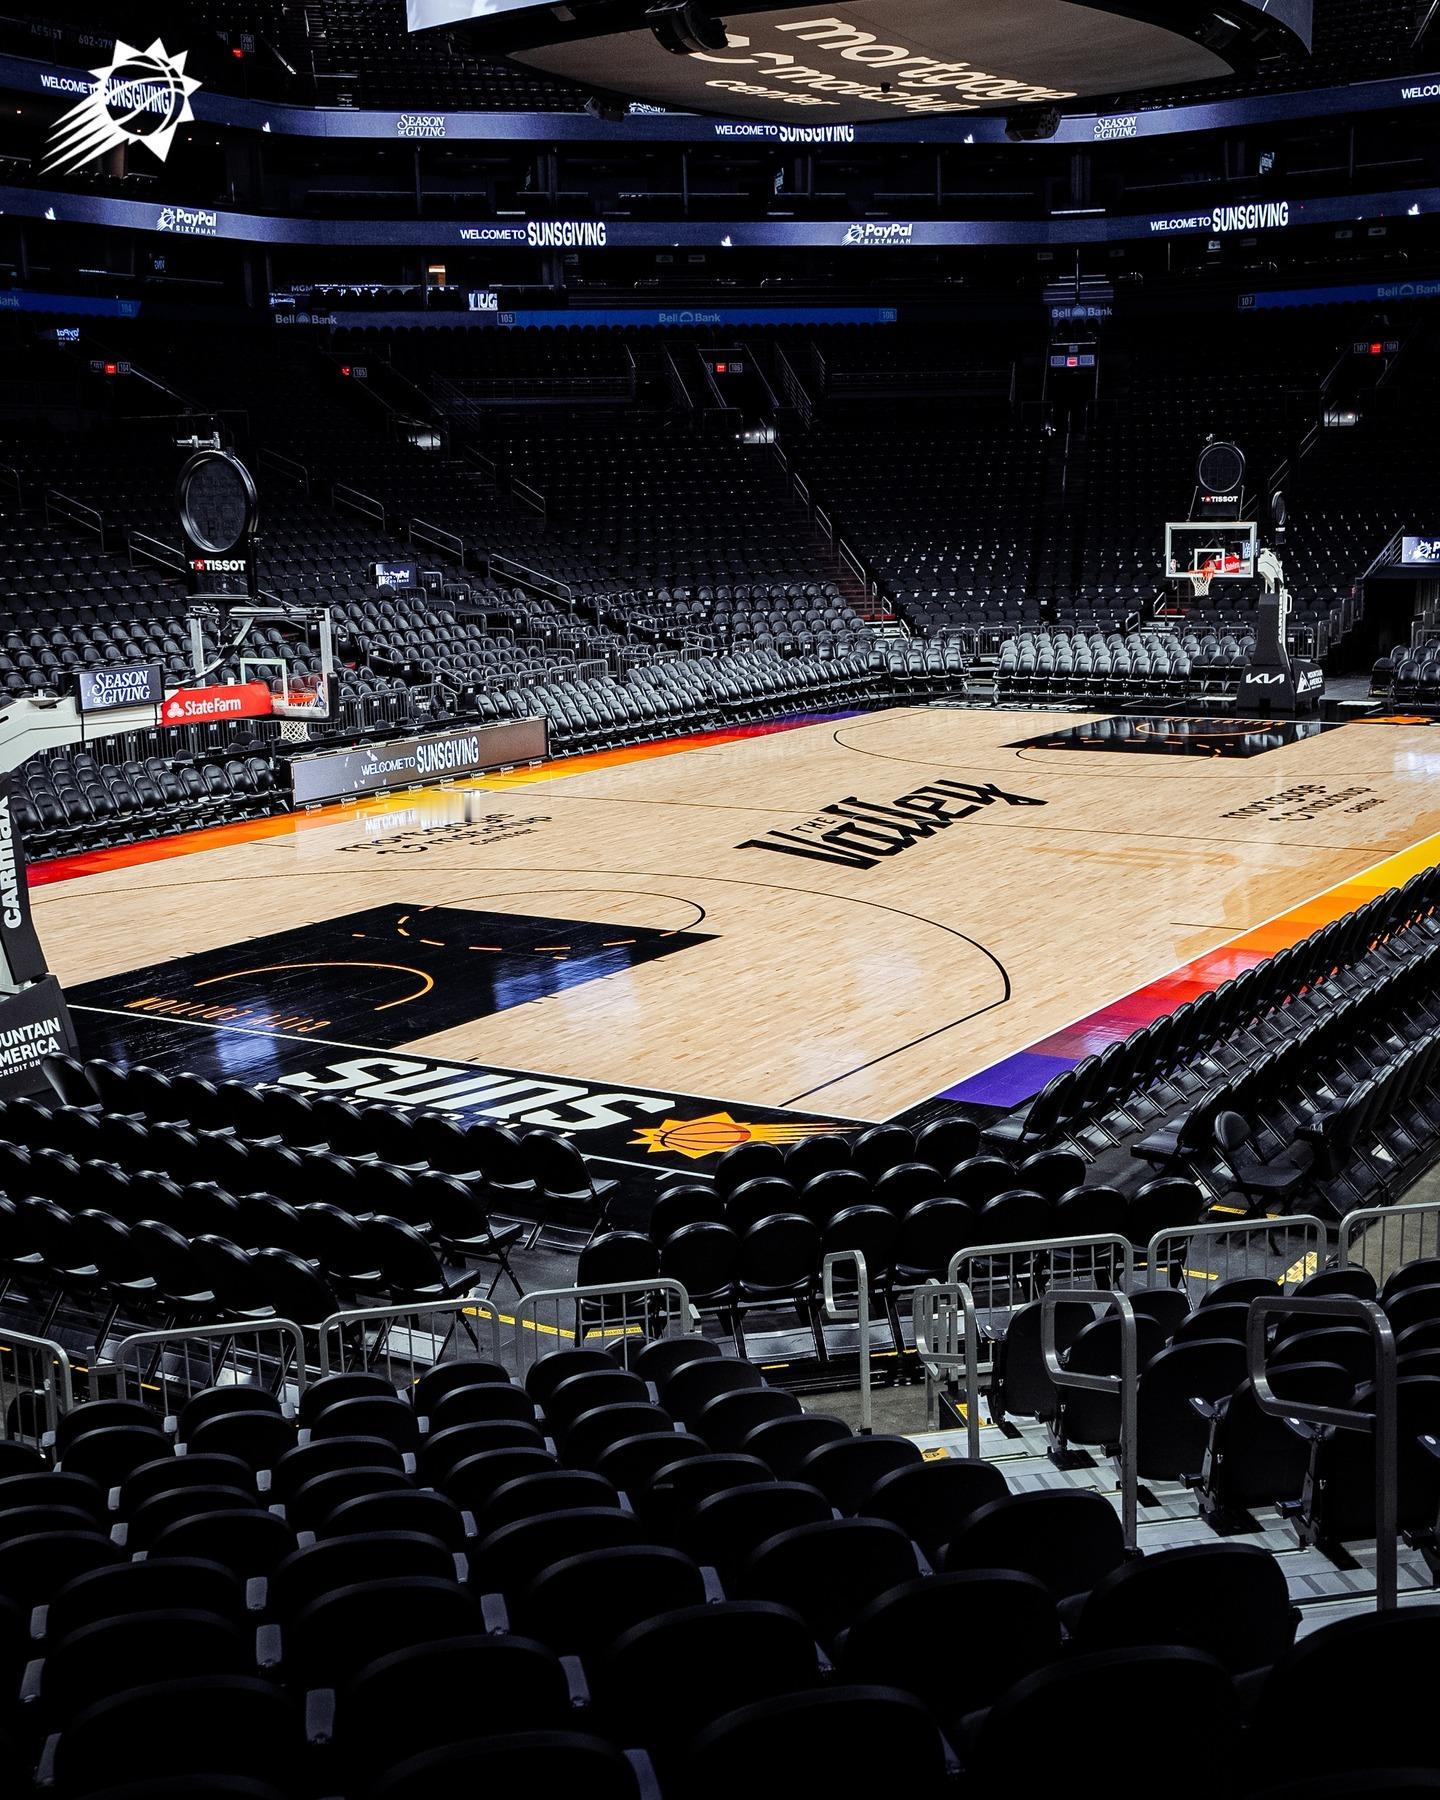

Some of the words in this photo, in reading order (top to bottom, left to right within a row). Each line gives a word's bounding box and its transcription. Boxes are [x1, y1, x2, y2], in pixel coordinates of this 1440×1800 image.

[774, 17, 1079, 102] mortgage
[40, 74, 88, 94] WELCOME
[705, 79, 841, 107] center
[758, 64, 981, 113] matchup
[1401, 84, 1440, 99] WELCO
[397, 113, 446, 129] SEASON
[715, 124, 763, 135] WELCOME
[763, 125, 778, 135] TO
[1094, 116, 1138, 134] SEASON
[405, 126, 446, 137] GIVING
[1101, 126, 1137, 139] GIVING
[176, 208, 217, 227] PayPal
[1150, 218, 1198, 231] WELCOME
[1198, 216, 1211, 227] TO
[1212, 201, 1289, 232] SUNSGIVING
[460, 229, 512, 239] WELCOME
[512, 229, 526, 239] TO
[527, 221, 607, 247] SUNSGIVING
[864, 223, 913, 239] PayPal
[1377, 286, 1398, 297] Bell
[0, 295, 20, 308] ank
[1241, 297, 1253, 306] 107
[275, 314, 295, 324] Bell
[311, 314, 338, 325] Bank
[500, 313, 514, 323] 105
[658, 313, 678, 323] Bell
[694, 313, 721, 323] Bank
[1051, 308, 1071, 318] Bell
[1087, 307, 1113, 317] Bank
[91, 670, 149, 696] SEASON
[102, 685, 151, 706] GIVING
[361, 758, 404, 777] WELCOME
[403, 756, 416, 769] TO
[416, 735, 480, 774] SUNSGIVING
[791, 816, 837, 835] THE
[0, 1036, 61, 1068] MERICA
[277, 1057, 676, 1131] SUNS
